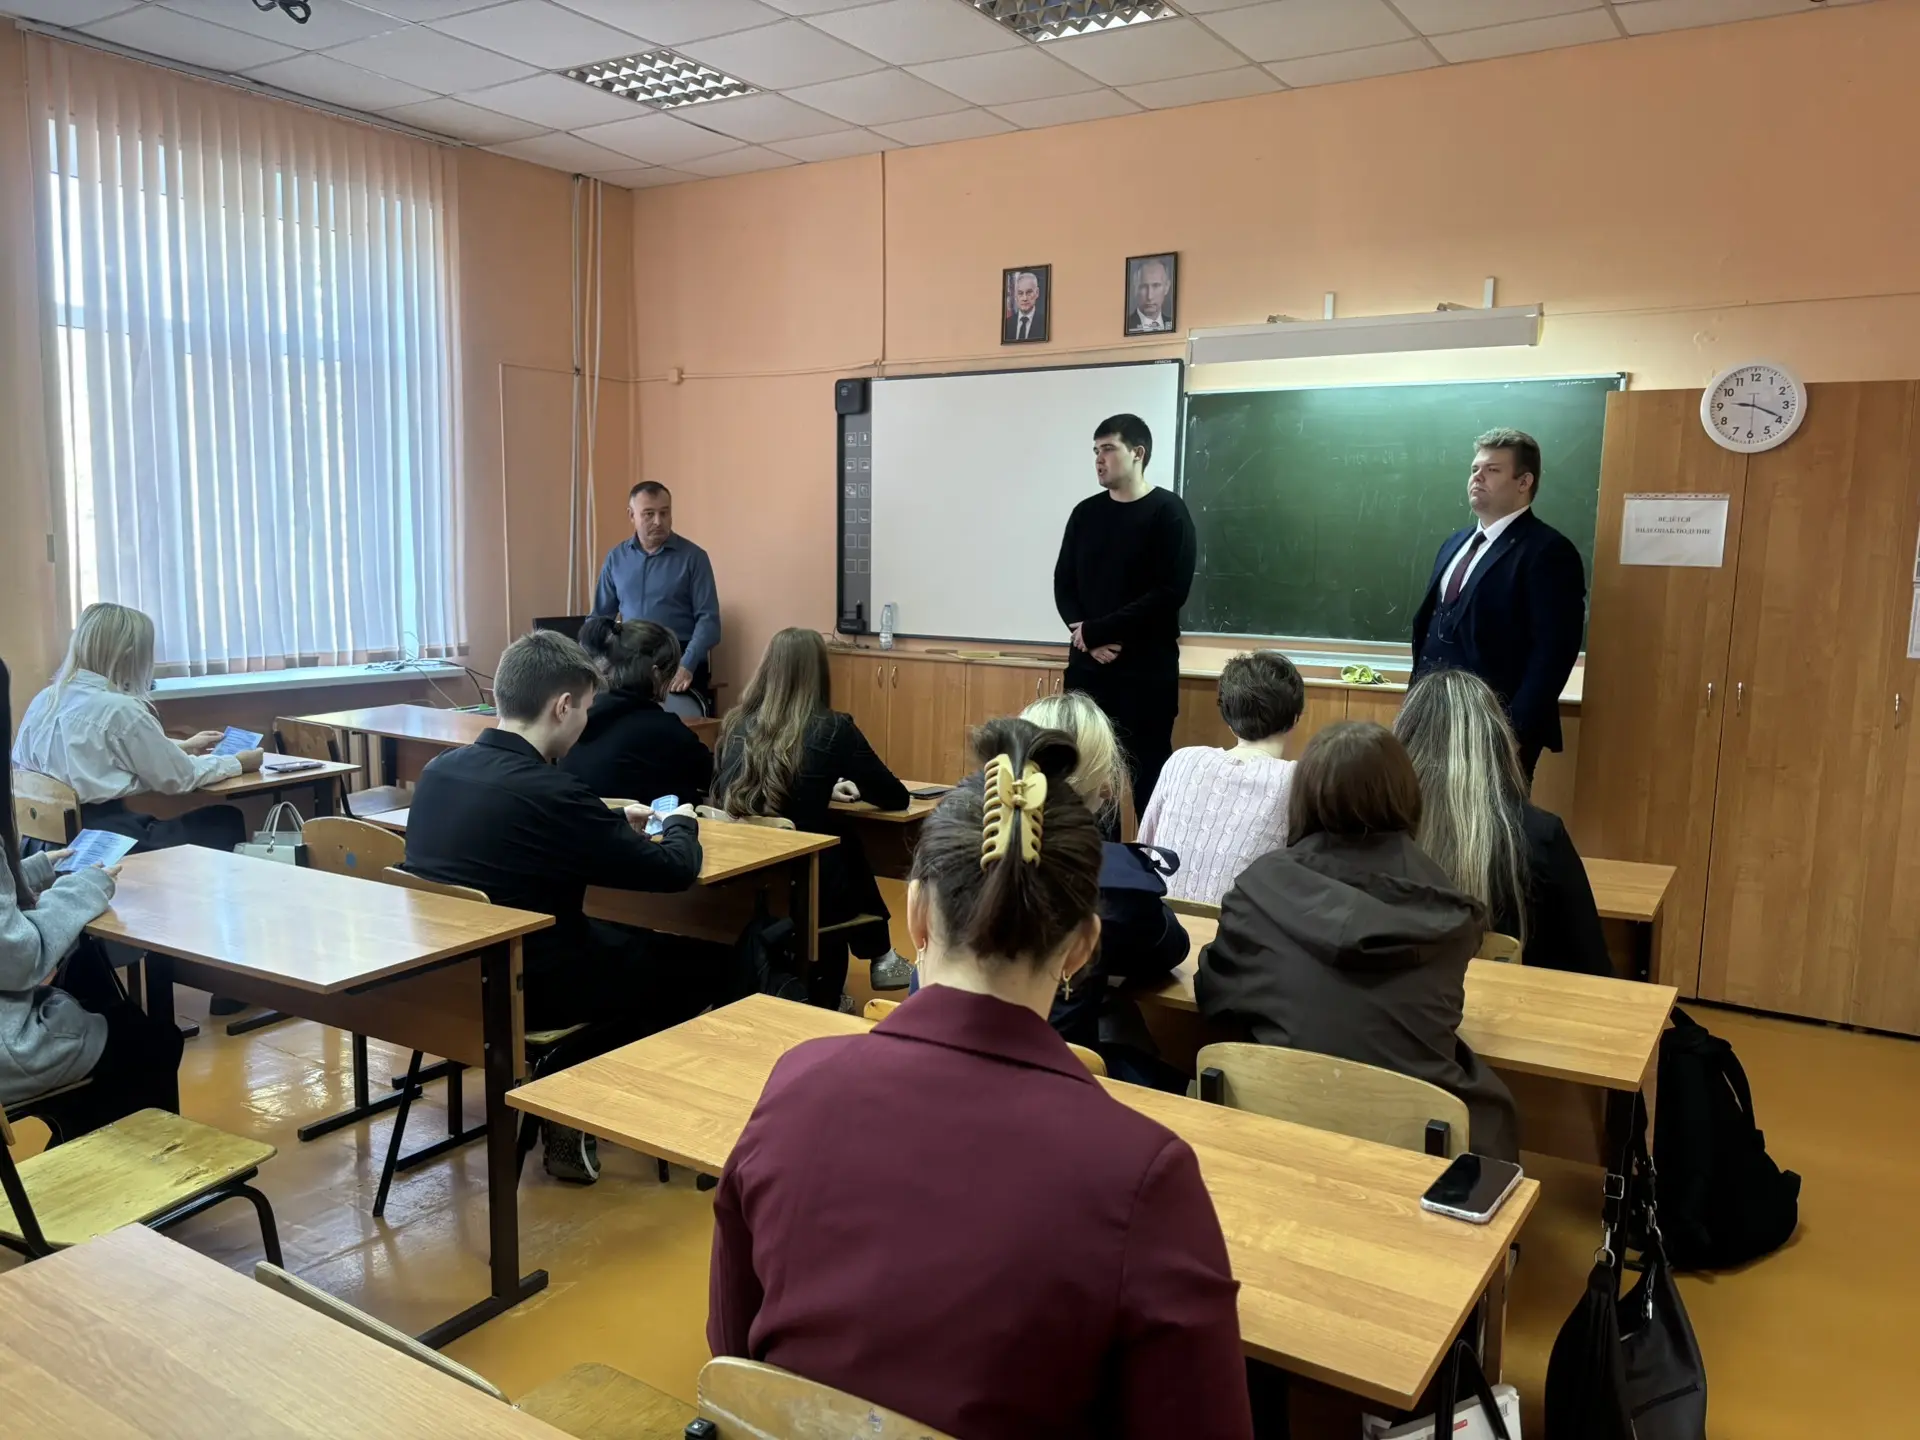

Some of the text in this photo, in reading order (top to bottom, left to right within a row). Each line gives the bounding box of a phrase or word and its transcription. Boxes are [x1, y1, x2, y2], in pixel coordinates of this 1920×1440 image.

[1735, 377, 1744, 387] 11
[1750, 373, 1762, 382] 12
[1769, 376, 1774, 385] 1
[1723, 388, 1735, 397] 10
[1778, 386, 1786, 396] 2
[1716, 402, 1724, 411] 9
[1782, 400, 1790, 410] 3
[1720, 416, 1728, 426] 8
[1774, 415, 1783, 424] 4
[1732, 426, 1740, 436] 7
[1746, 429, 1754, 439] 6
[1763, 425, 1771, 435] 5
